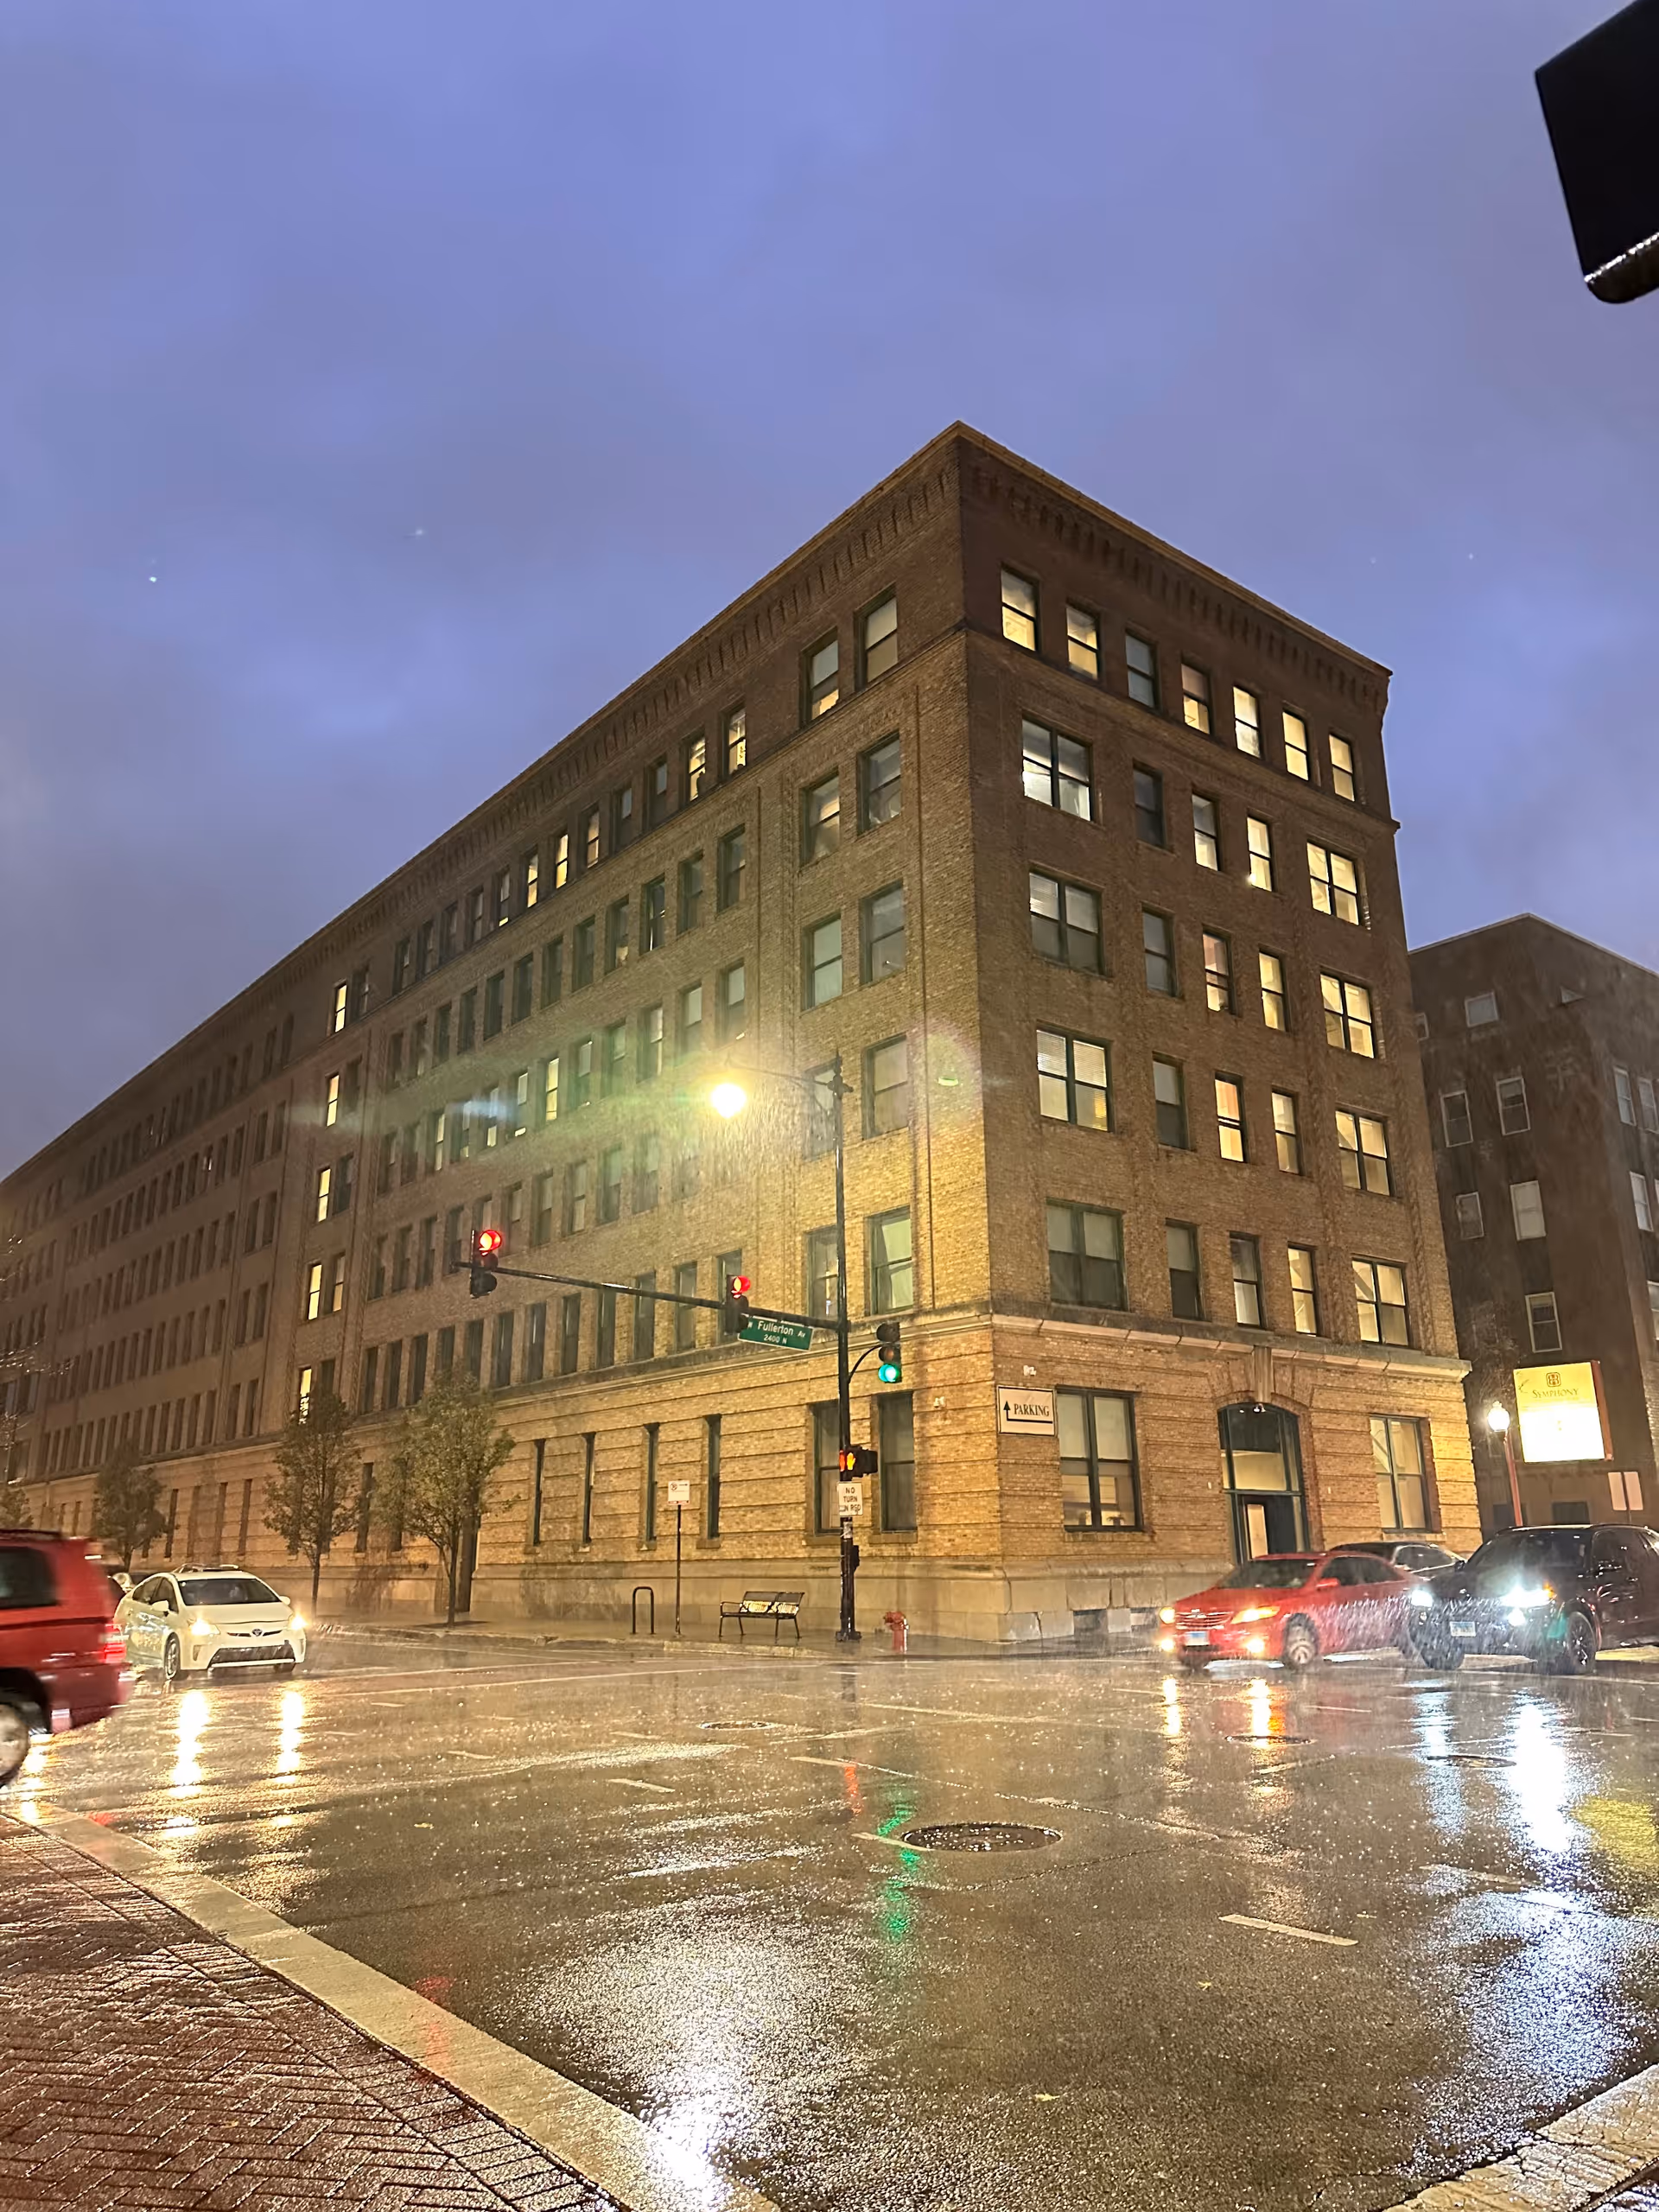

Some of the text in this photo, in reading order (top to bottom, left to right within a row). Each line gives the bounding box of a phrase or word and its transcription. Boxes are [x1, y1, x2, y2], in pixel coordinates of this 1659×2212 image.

[757, 1320, 794, 1336] Fullerton
[764, 1333, 780, 1344] 2400
[1532, 1388, 1580, 1399] SYMPHONY
[1014, 1403, 1050, 1417] PARKING
